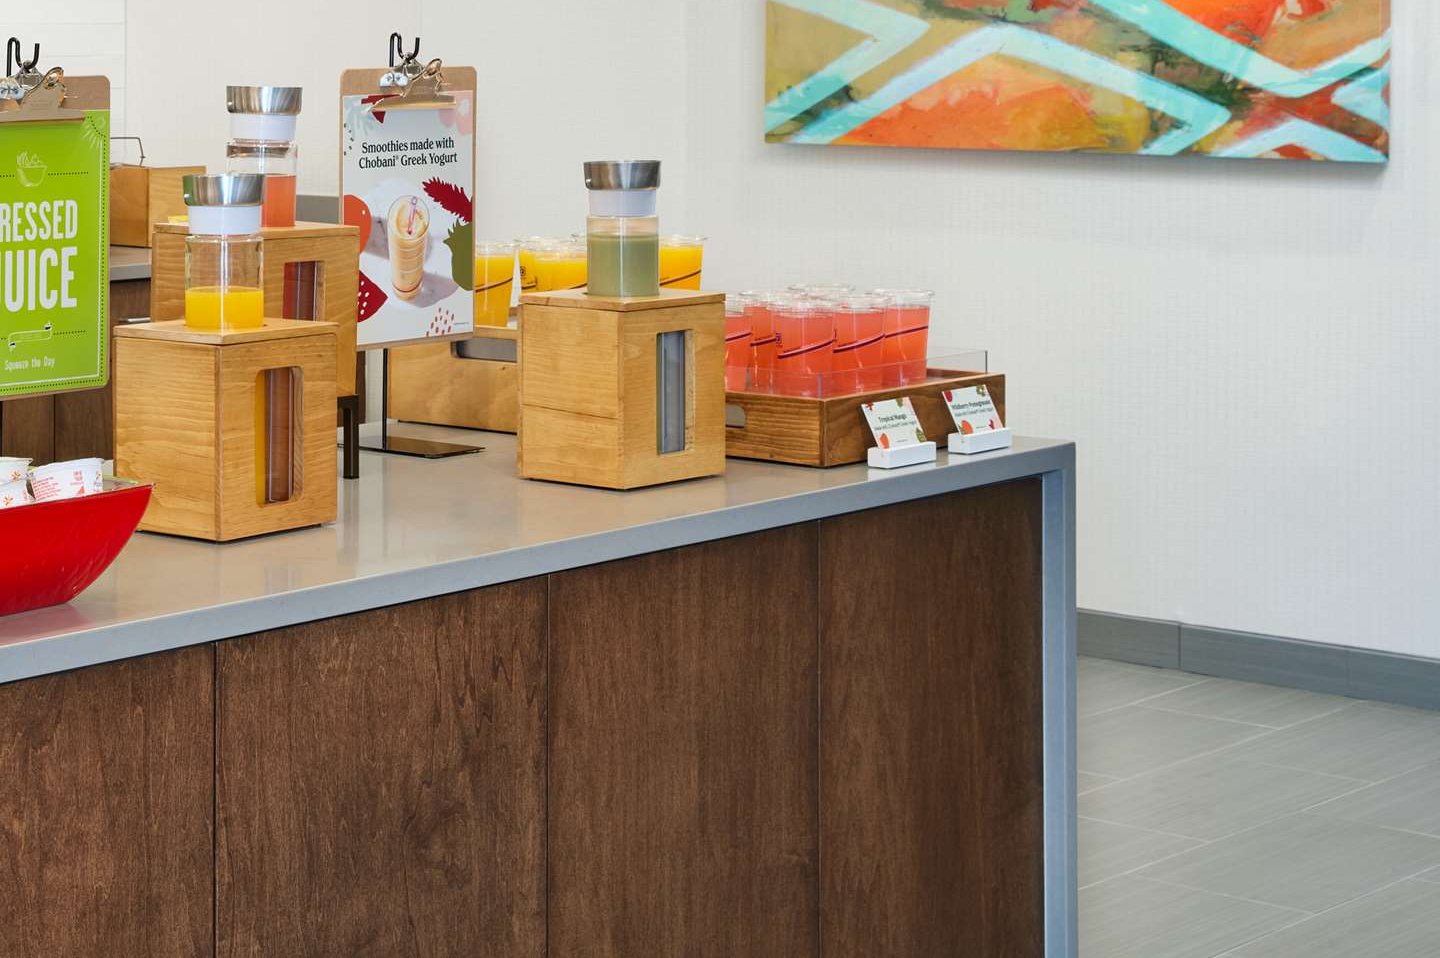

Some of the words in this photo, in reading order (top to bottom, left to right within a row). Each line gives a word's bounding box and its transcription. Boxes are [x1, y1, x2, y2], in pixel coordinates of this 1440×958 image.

[361, 139, 409, 154] Smoothies
[409, 138, 434, 151] made
[435, 136, 454, 149] with
[400, 153, 427, 167] Greek
[428, 152, 458, 167] Yogurt
